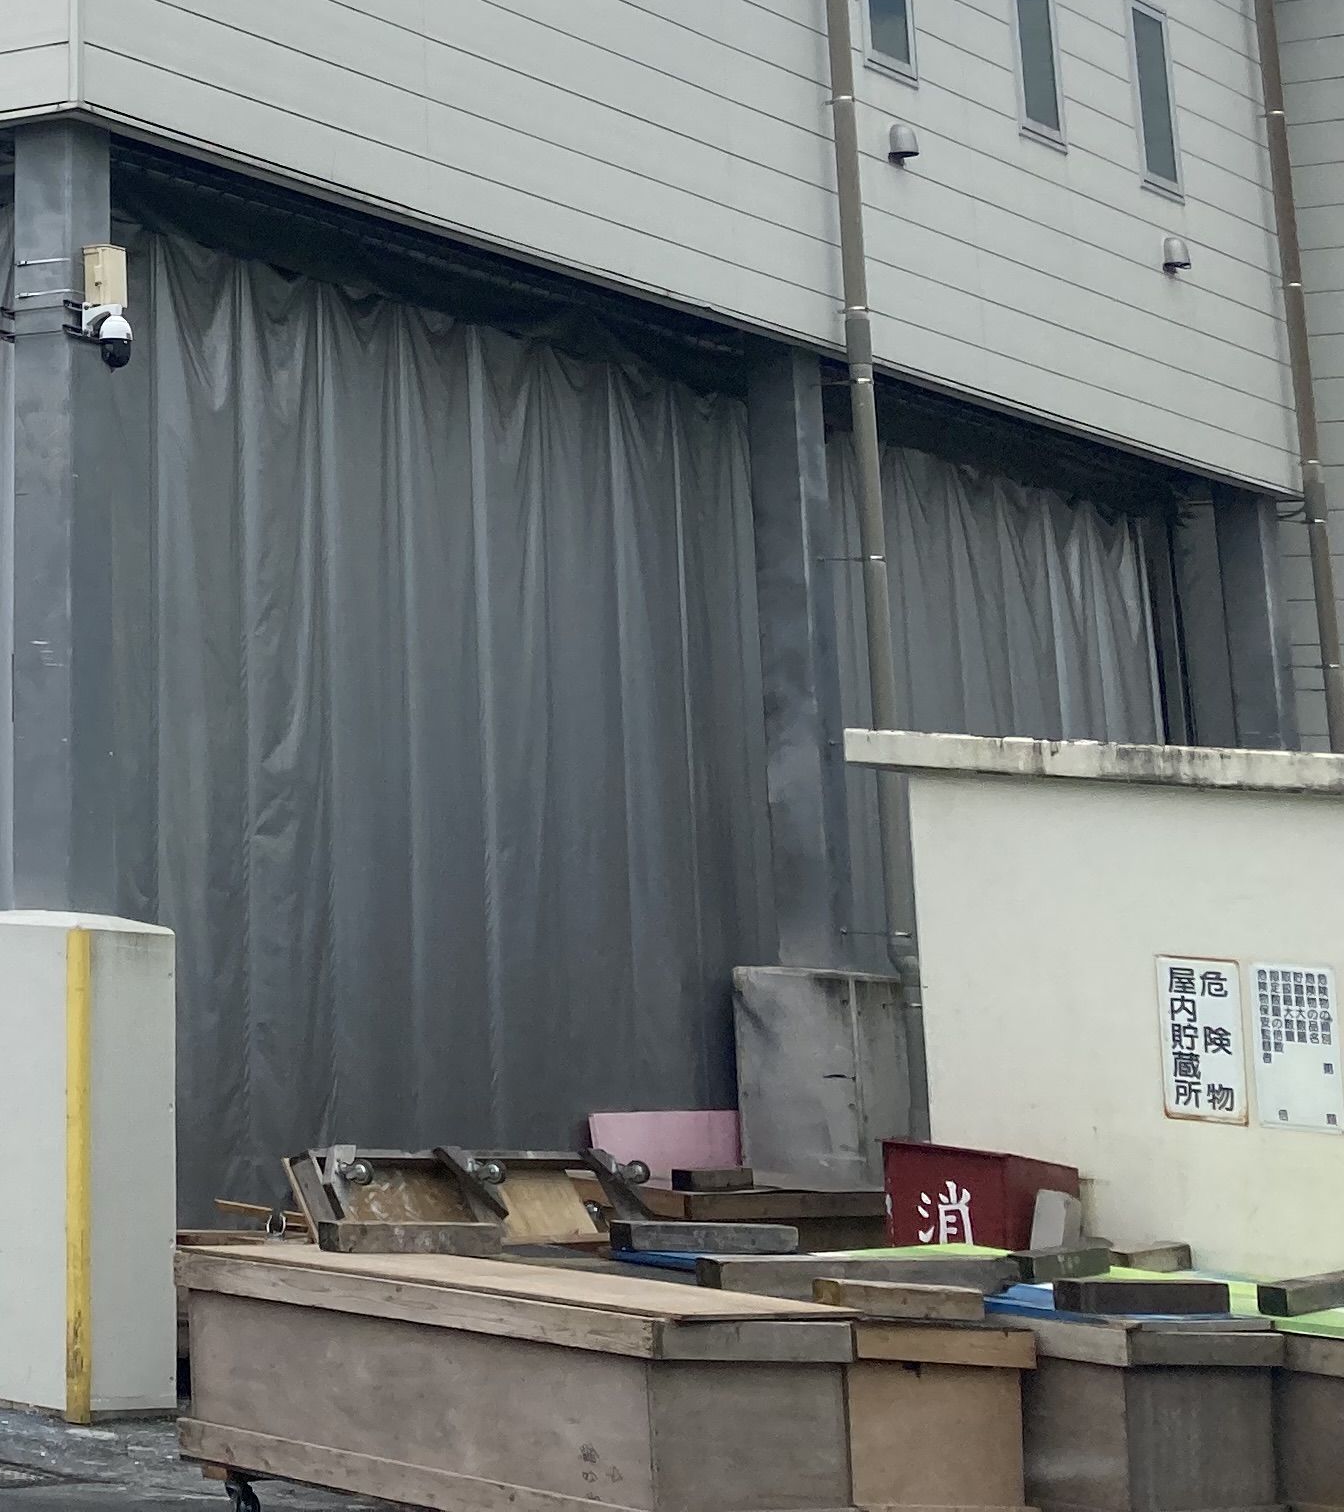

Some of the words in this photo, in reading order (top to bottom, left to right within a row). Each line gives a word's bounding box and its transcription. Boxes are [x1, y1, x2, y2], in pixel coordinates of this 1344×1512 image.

[1168, 967, 1202, 1108] 屋内貯蔵所
[1200, 971, 1235, 1111] 危険物
[917, 1180, 973, 1245] 消
